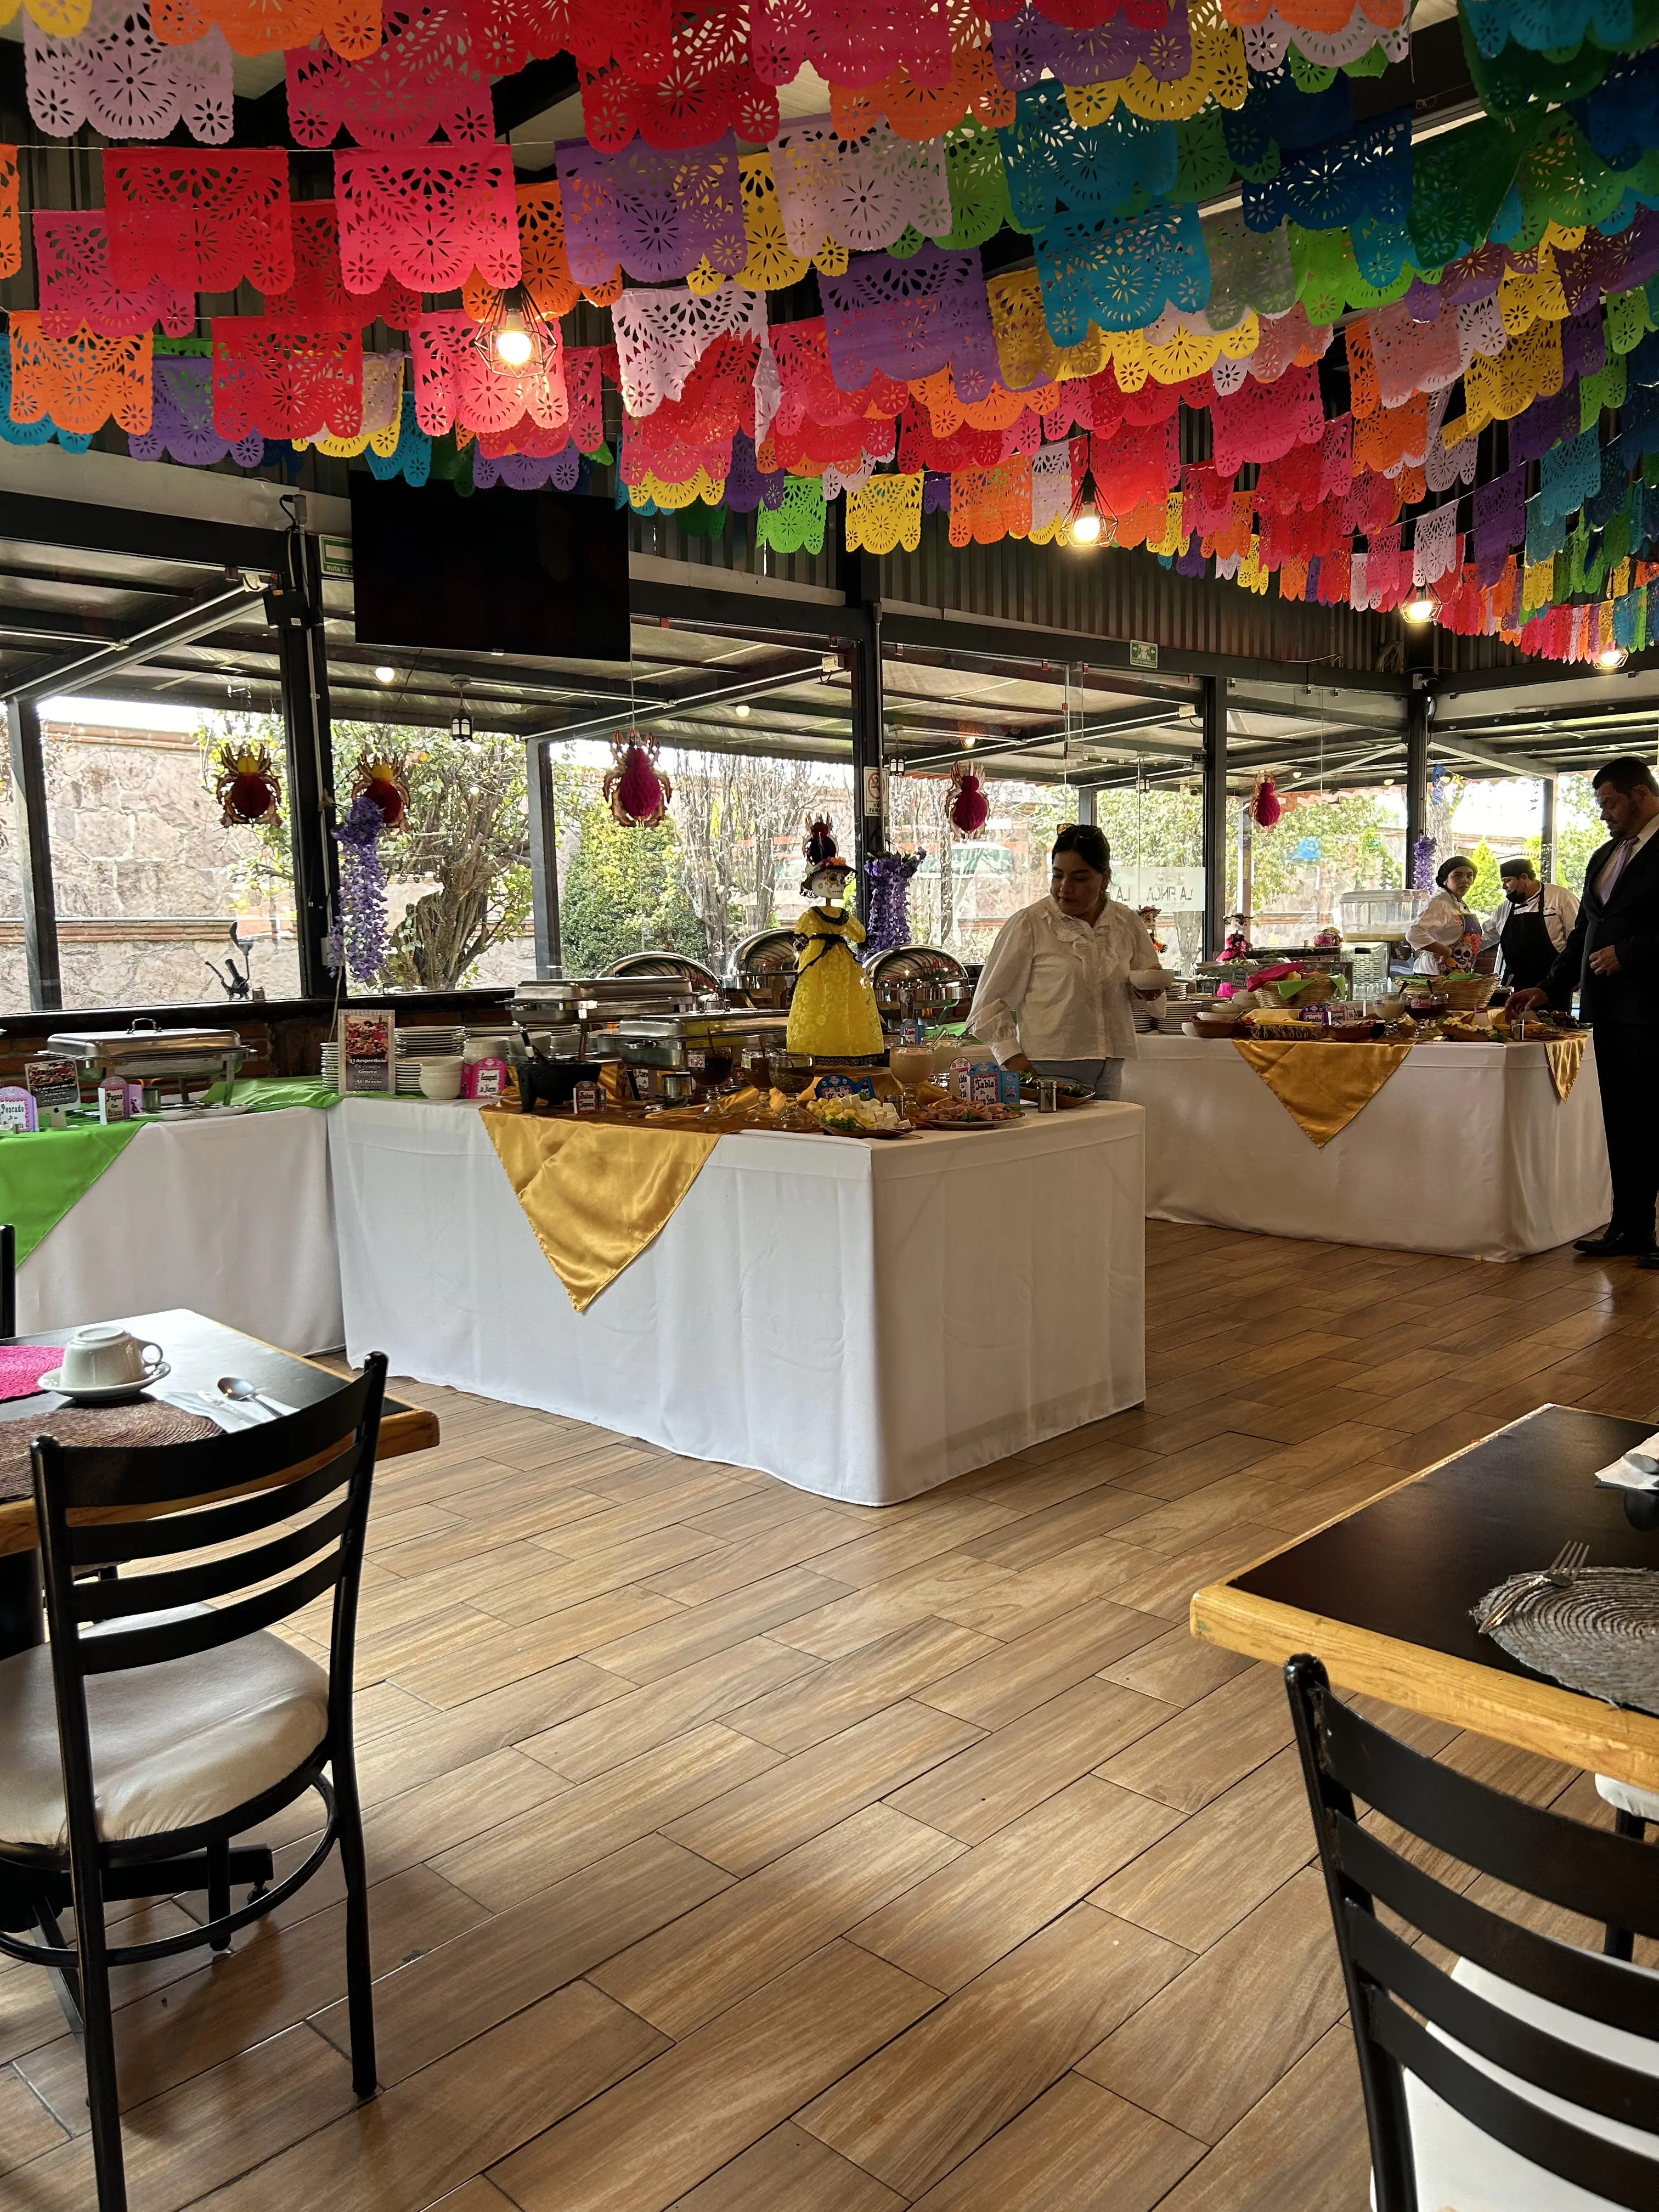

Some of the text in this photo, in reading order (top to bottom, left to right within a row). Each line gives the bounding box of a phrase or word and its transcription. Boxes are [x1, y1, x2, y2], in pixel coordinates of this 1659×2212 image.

[975, 1079, 994, 1090] Tabla
[106, 1093, 123, 1102] Papas
[1, 1104, 24, 1114] Pescado
